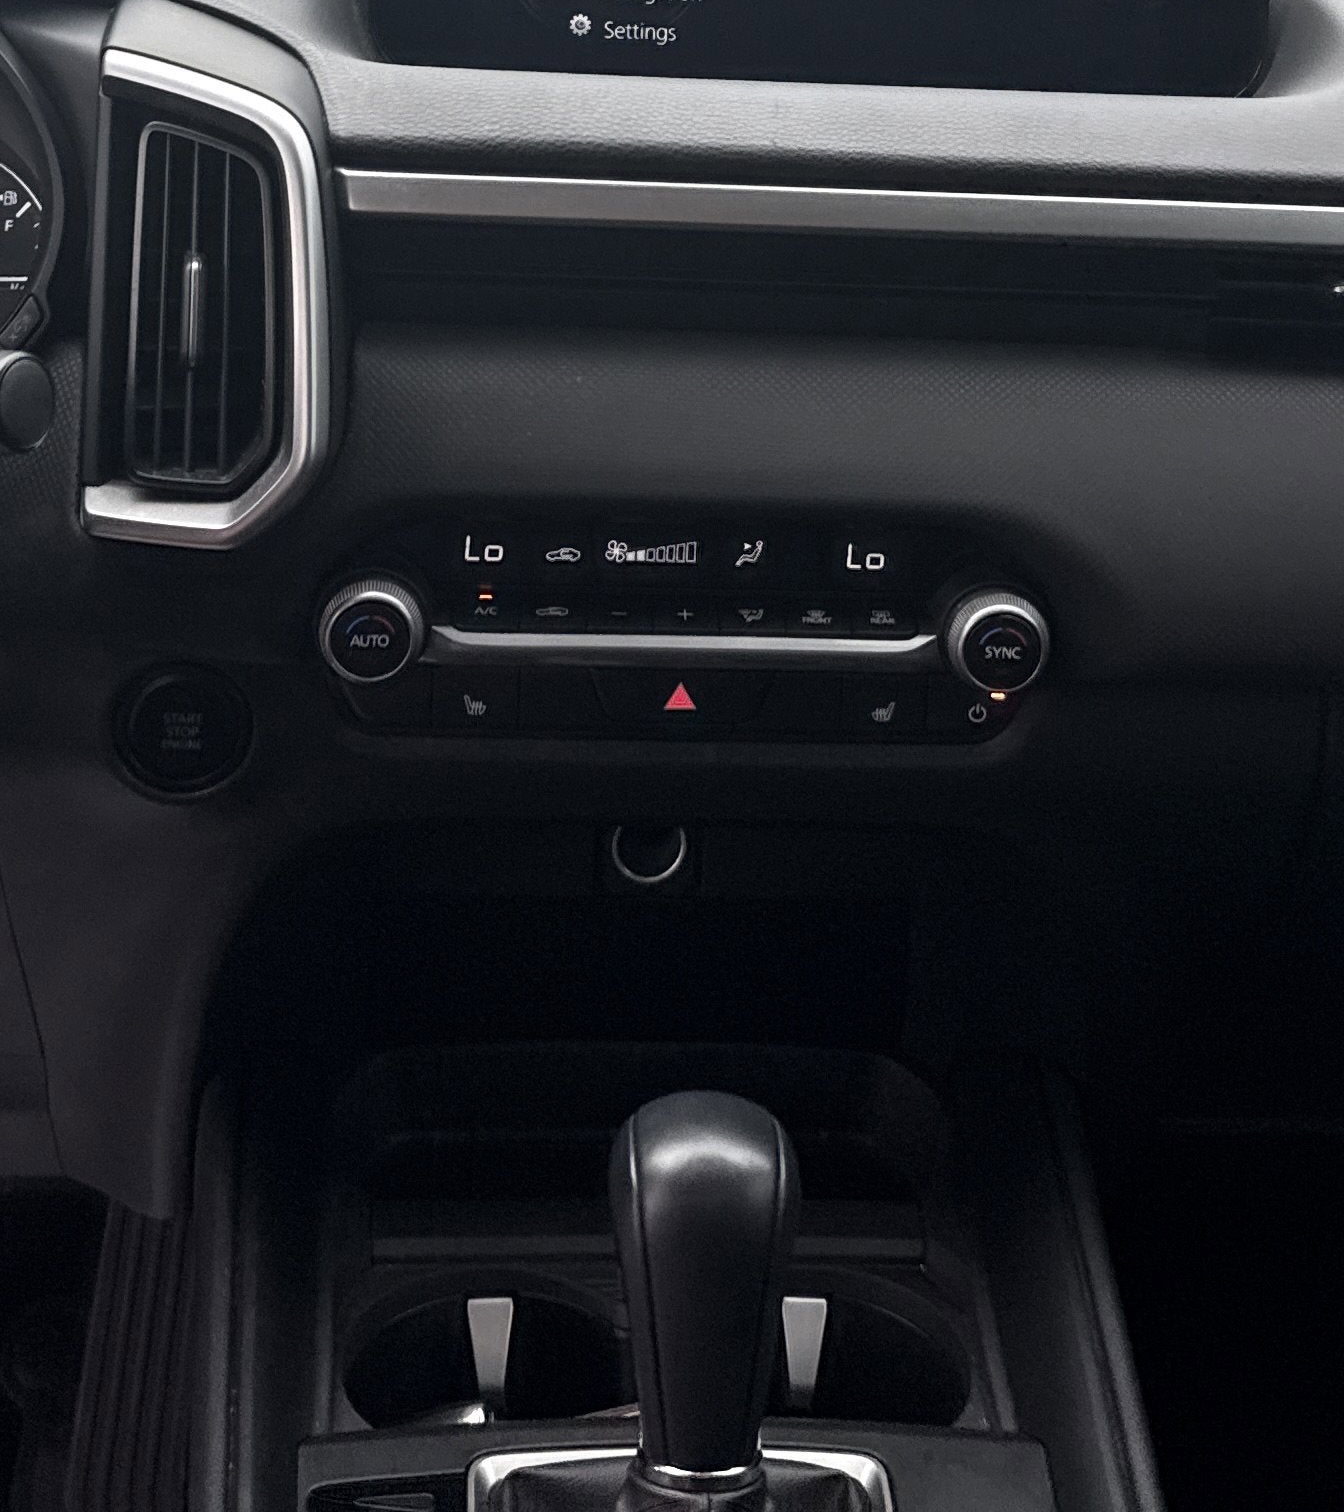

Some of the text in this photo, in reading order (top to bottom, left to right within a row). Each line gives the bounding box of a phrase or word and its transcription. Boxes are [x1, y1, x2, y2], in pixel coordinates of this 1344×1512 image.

[604, 20, 676, 45] Settings
[5, 220, 14, 231] F
[465, 536, 503, 561] Lo
[846, 543, 884, 570] Lo
[475, 606, 496, 616] A/C
[350, 635, 389, 648] AUTO
[985, 646, 1021, 660] SYNC
